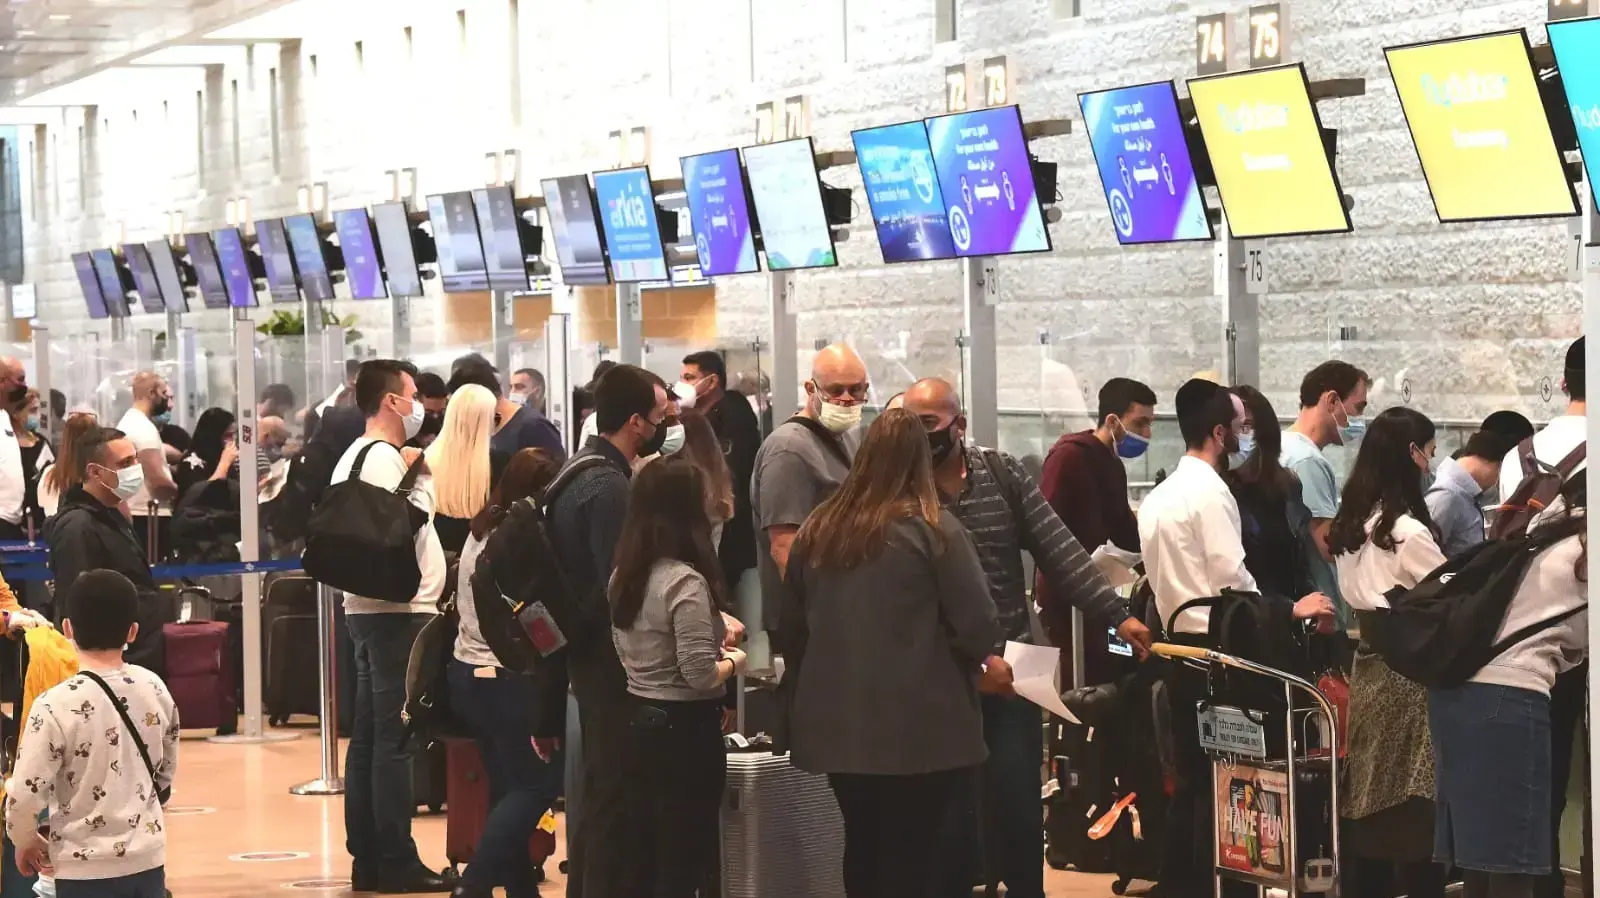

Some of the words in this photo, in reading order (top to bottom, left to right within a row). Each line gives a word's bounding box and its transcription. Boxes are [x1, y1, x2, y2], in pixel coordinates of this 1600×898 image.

[1198, 22, 1225, 63] 74
[1250, 12, 1279, 58] 75
[1249, 250, 1263, 282] 75
[1574, 234, 1582, 270] 7
[1224, 805, 1257, 836] HAVE
